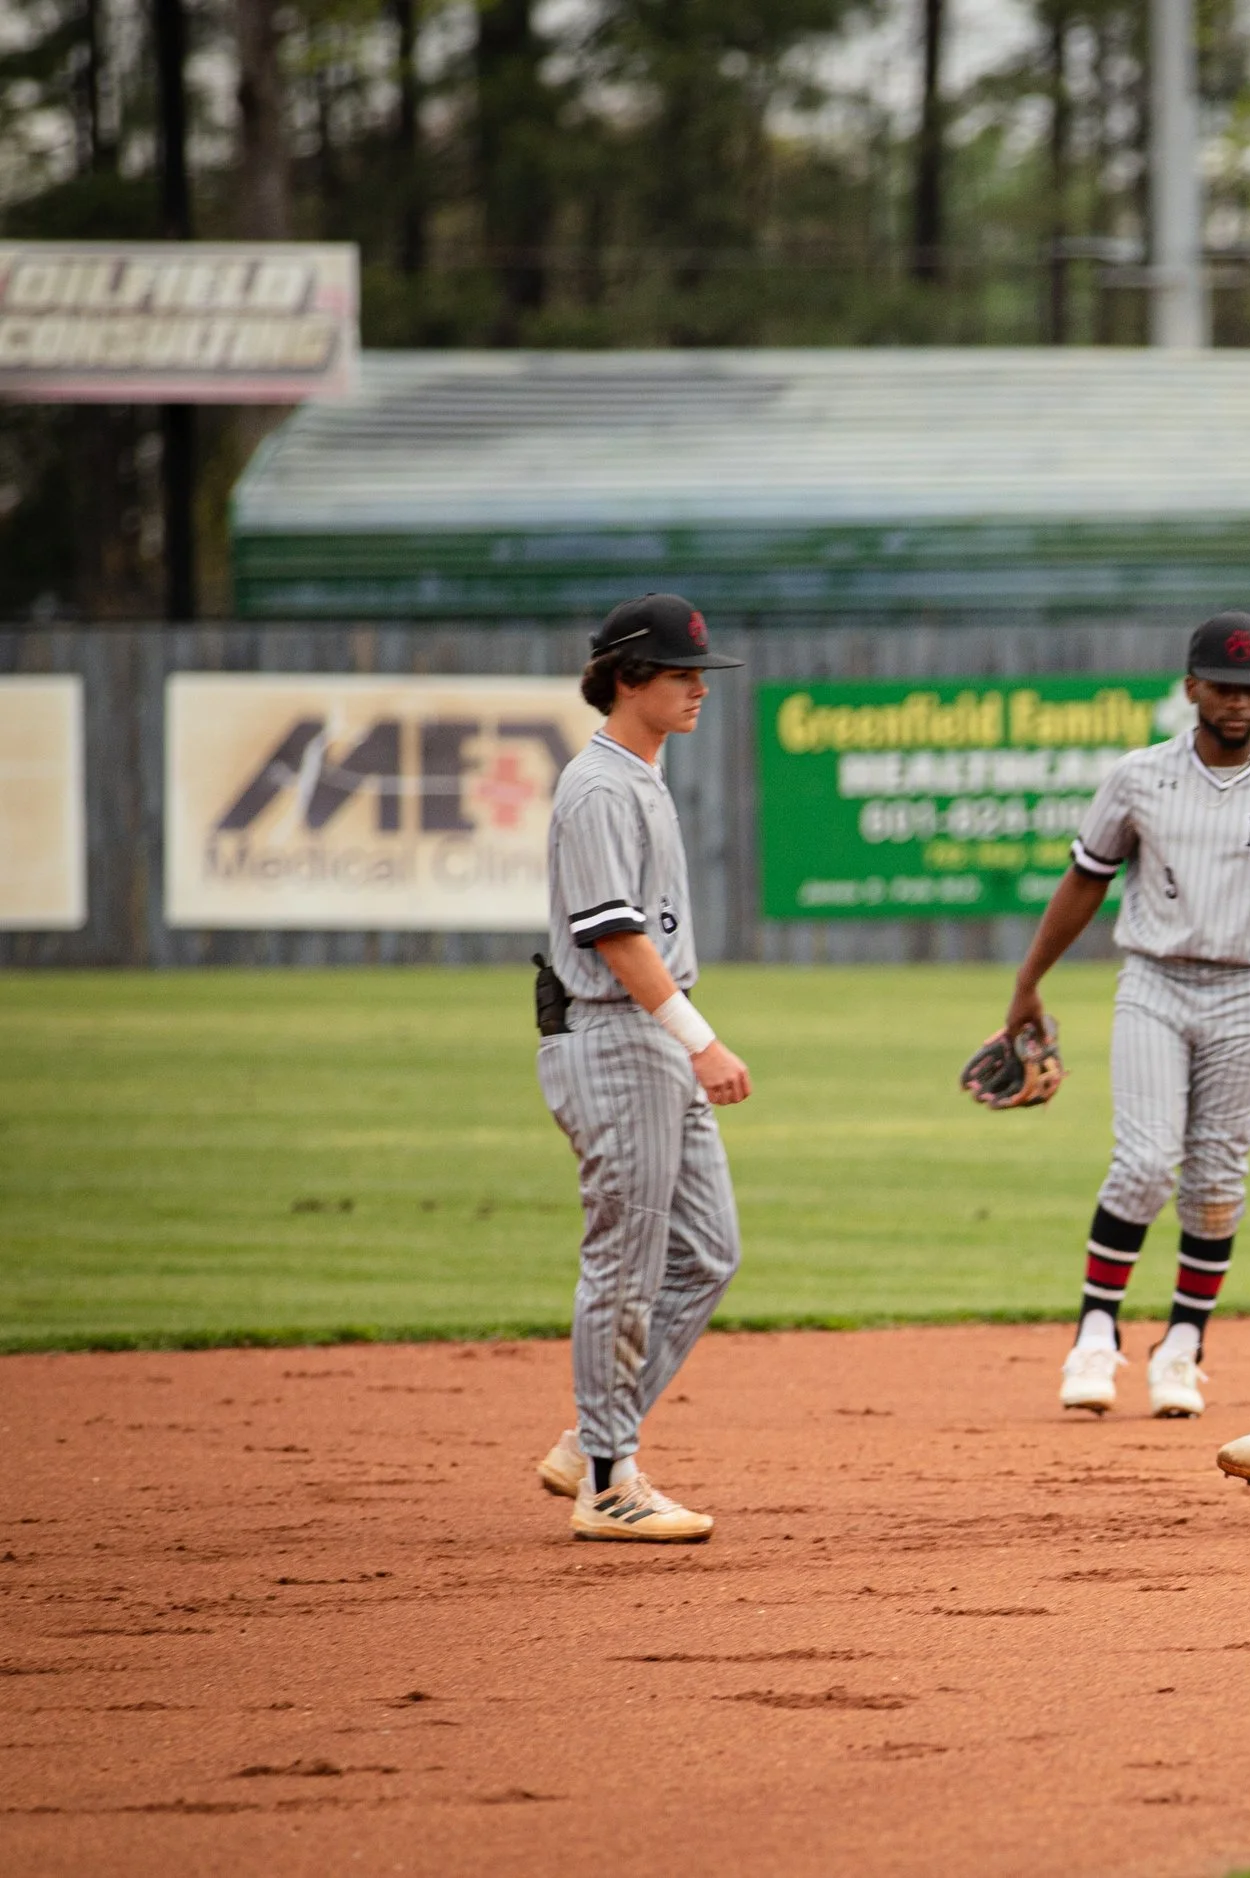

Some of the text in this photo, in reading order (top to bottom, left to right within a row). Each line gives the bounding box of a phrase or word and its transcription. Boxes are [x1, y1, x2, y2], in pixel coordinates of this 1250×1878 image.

[776, 687, 1153, 754] Greenfield Family
[837, 750, 1126, 797] HEALTHCA
[428, 836, 552, 892] Clin
